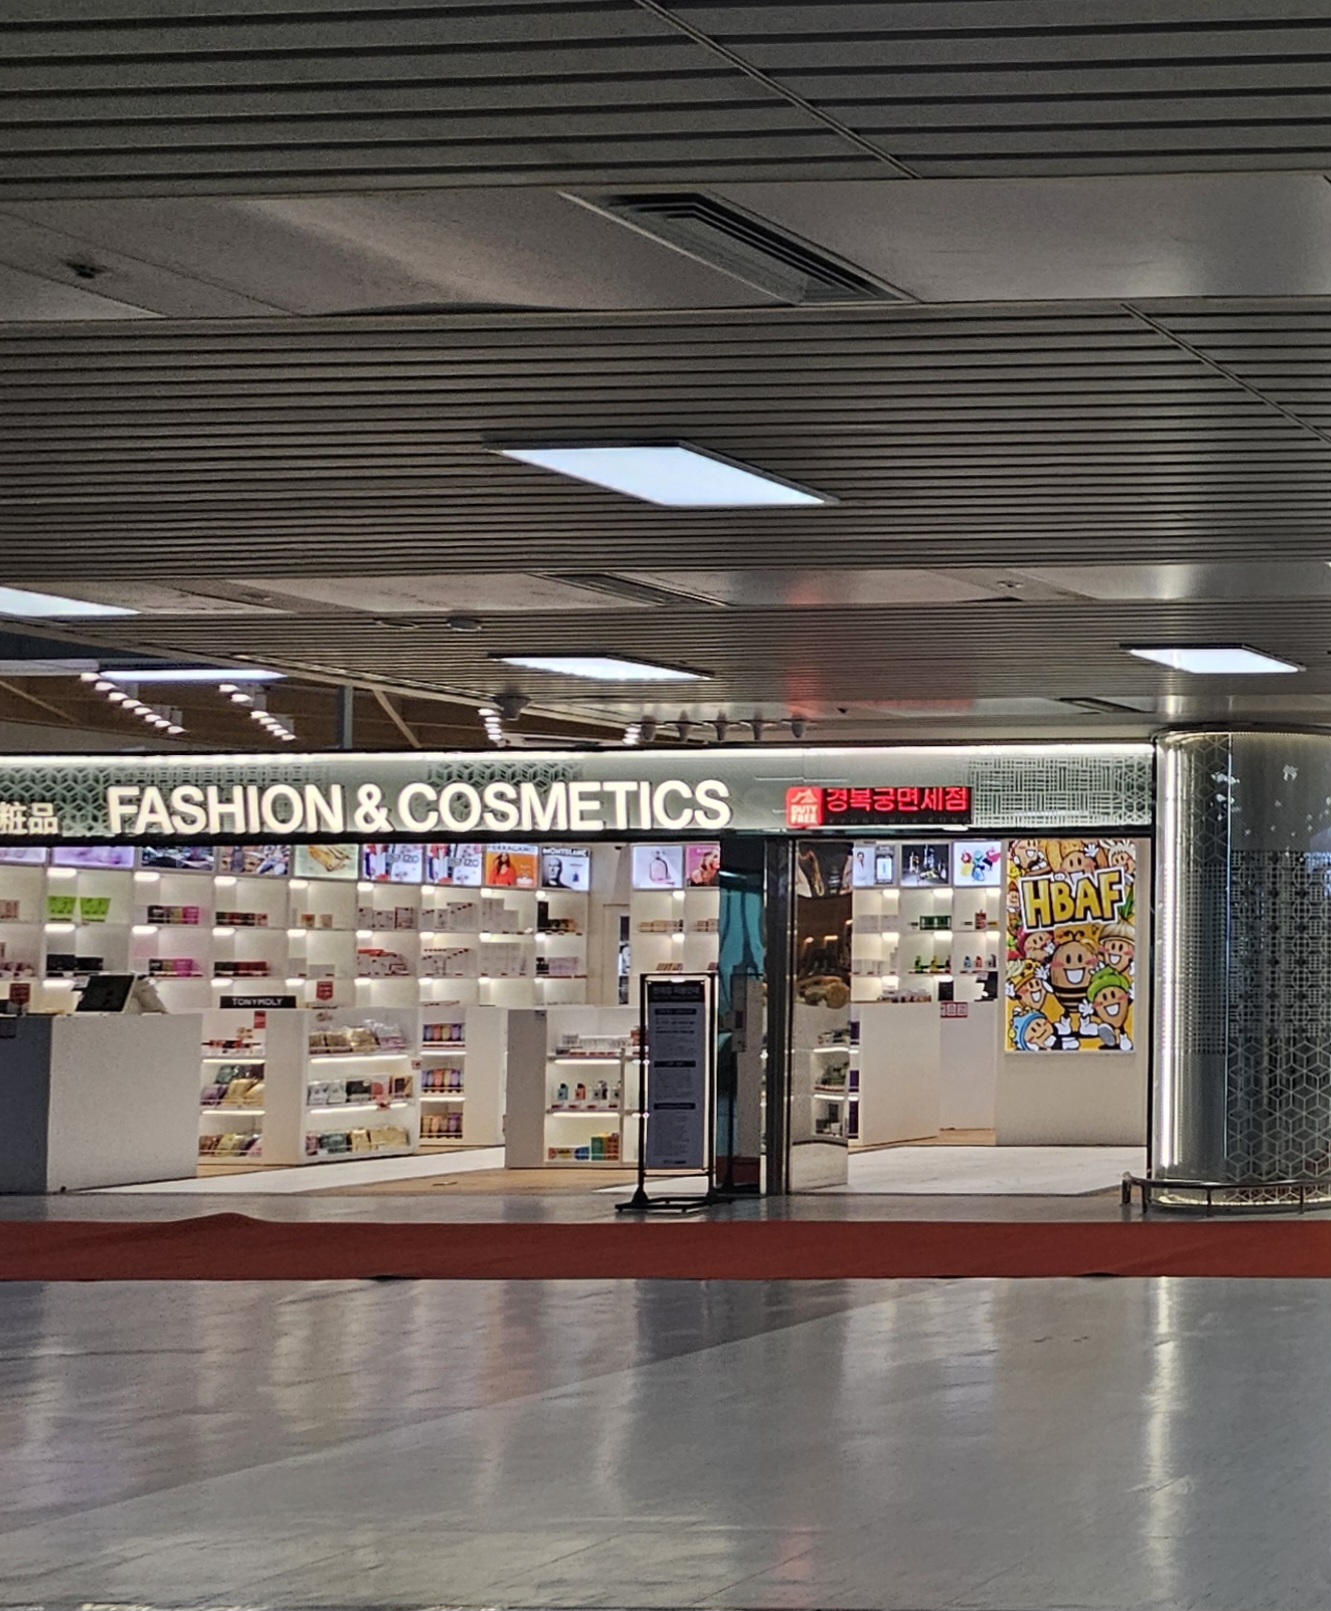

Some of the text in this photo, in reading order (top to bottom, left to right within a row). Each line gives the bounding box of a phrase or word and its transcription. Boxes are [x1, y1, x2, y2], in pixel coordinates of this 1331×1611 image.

[107, 780, 731, 834] FASHION & COSMETICS
[826, 787, 969, 812] 경복궁면세점
[790, 805, 818, 814] DUTY
[790, 813, 818, 824] FREE
[1021, 870, 1121, 928] HBAF
[232, 997, 283, 1006] TONYMOLY
